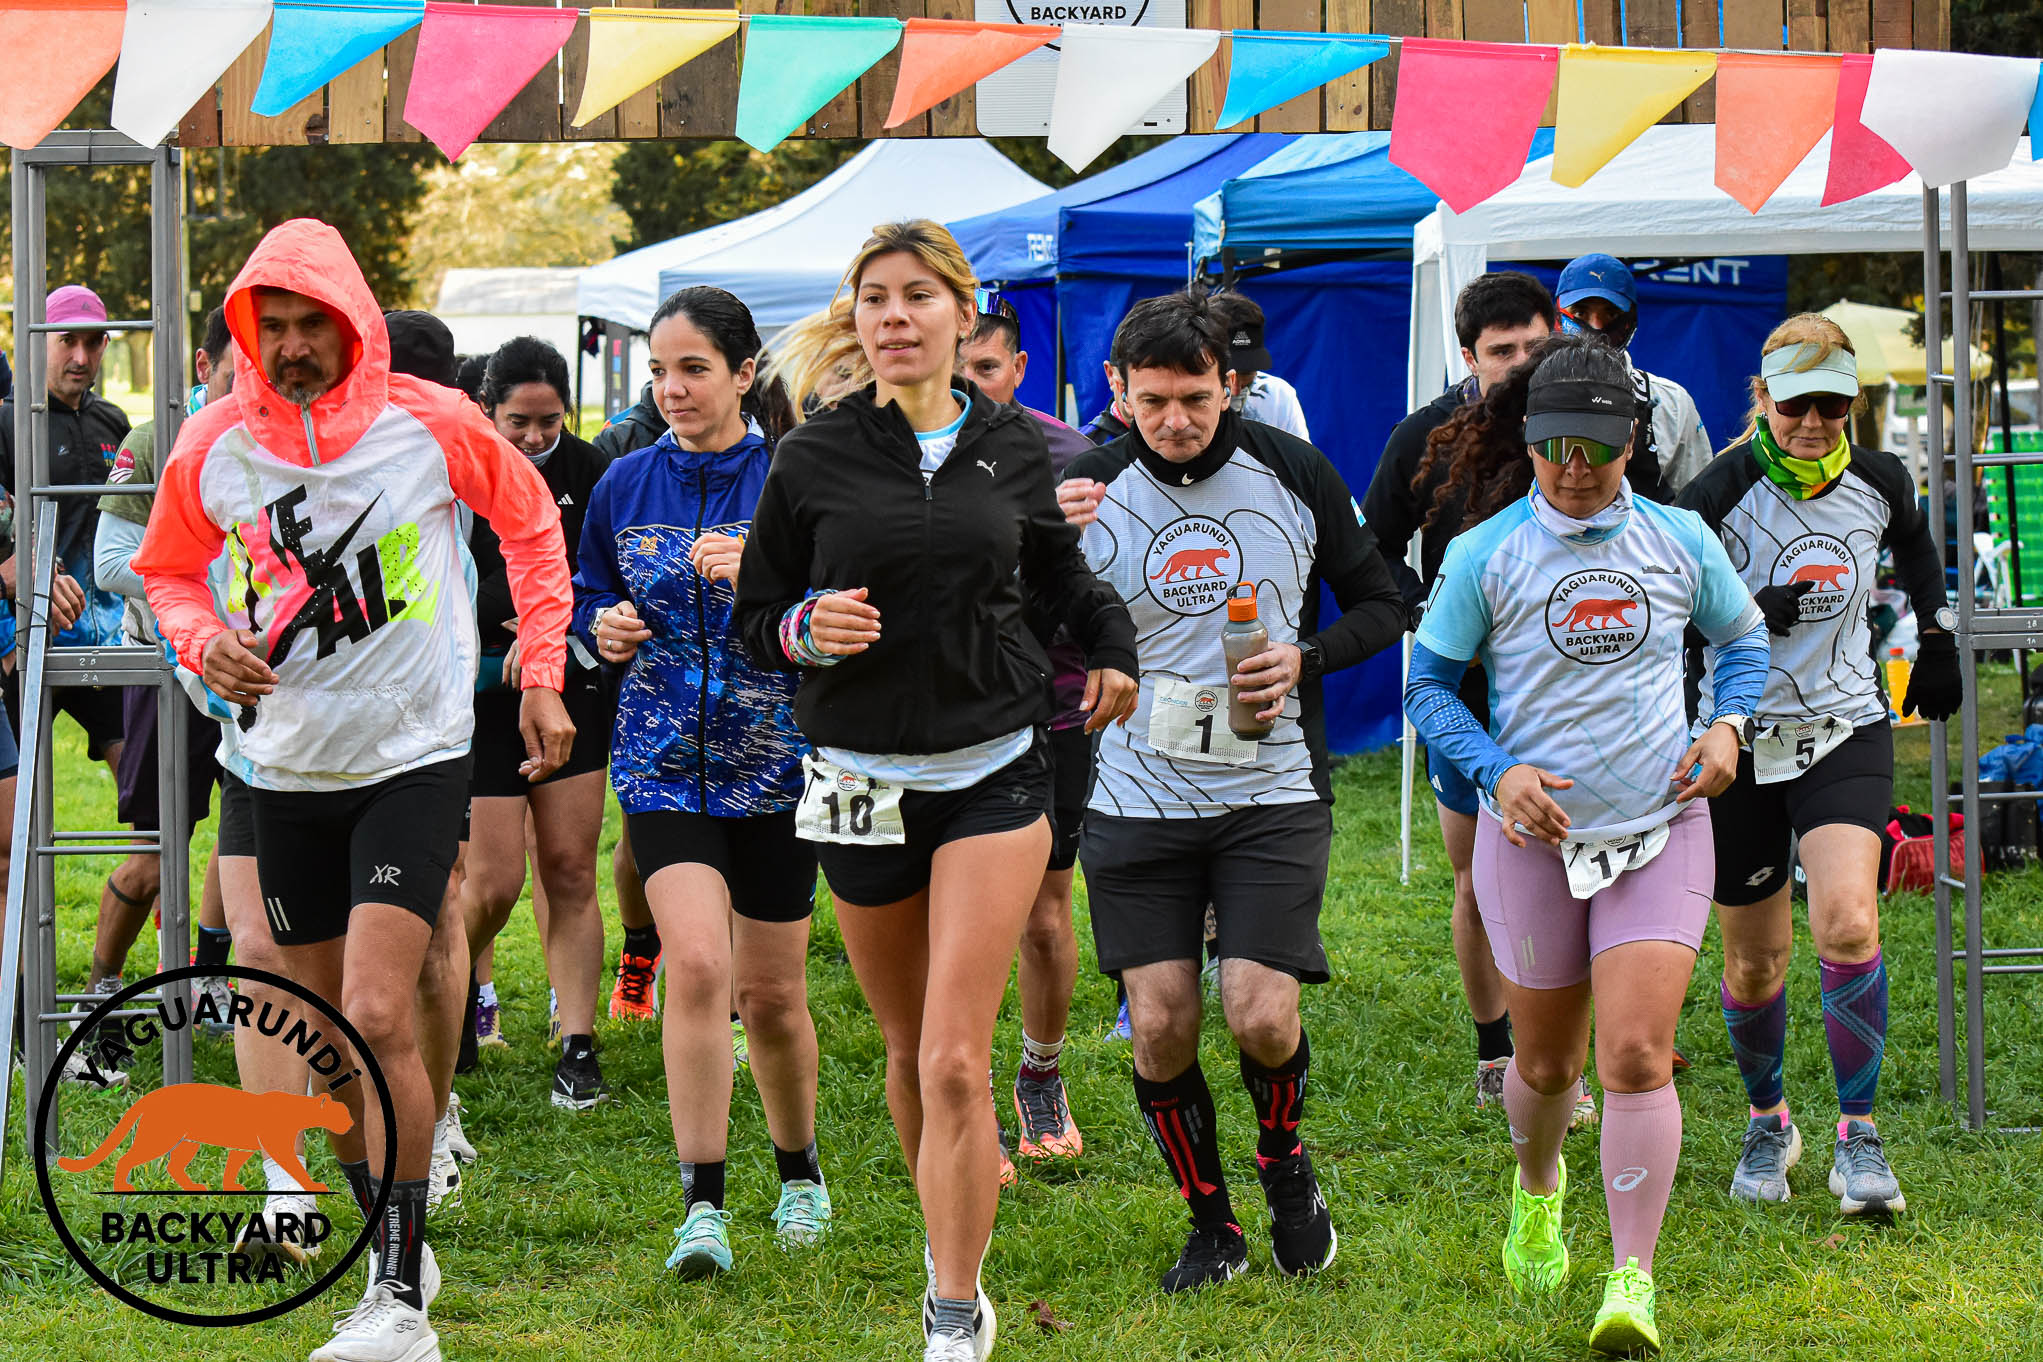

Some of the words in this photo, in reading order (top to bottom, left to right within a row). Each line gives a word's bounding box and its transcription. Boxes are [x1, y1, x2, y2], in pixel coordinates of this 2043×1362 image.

[1031, 6, 1127, 20] BACKYARD
[1163, 581, 1227, 598] BACKYARD
[1177, 594, 1216, 608] ULTRA
[1799, 594, 1845, 606] CKYARD
[1566, 632, 1635, 647] BACKYARD
[1580, 643, 1620, 655] ULTRA
[1195, 714, 1213, 754] 1
[1795, 736, 1816, 770] 5
[822, 791, 875, 836] 10
[1589, 841, 1641, 880] 17
[369, 863, 402, 886] XR
[387, 1205, 401, 1242] XTREME
[385, 1243, 400, 1277] RUNNER
